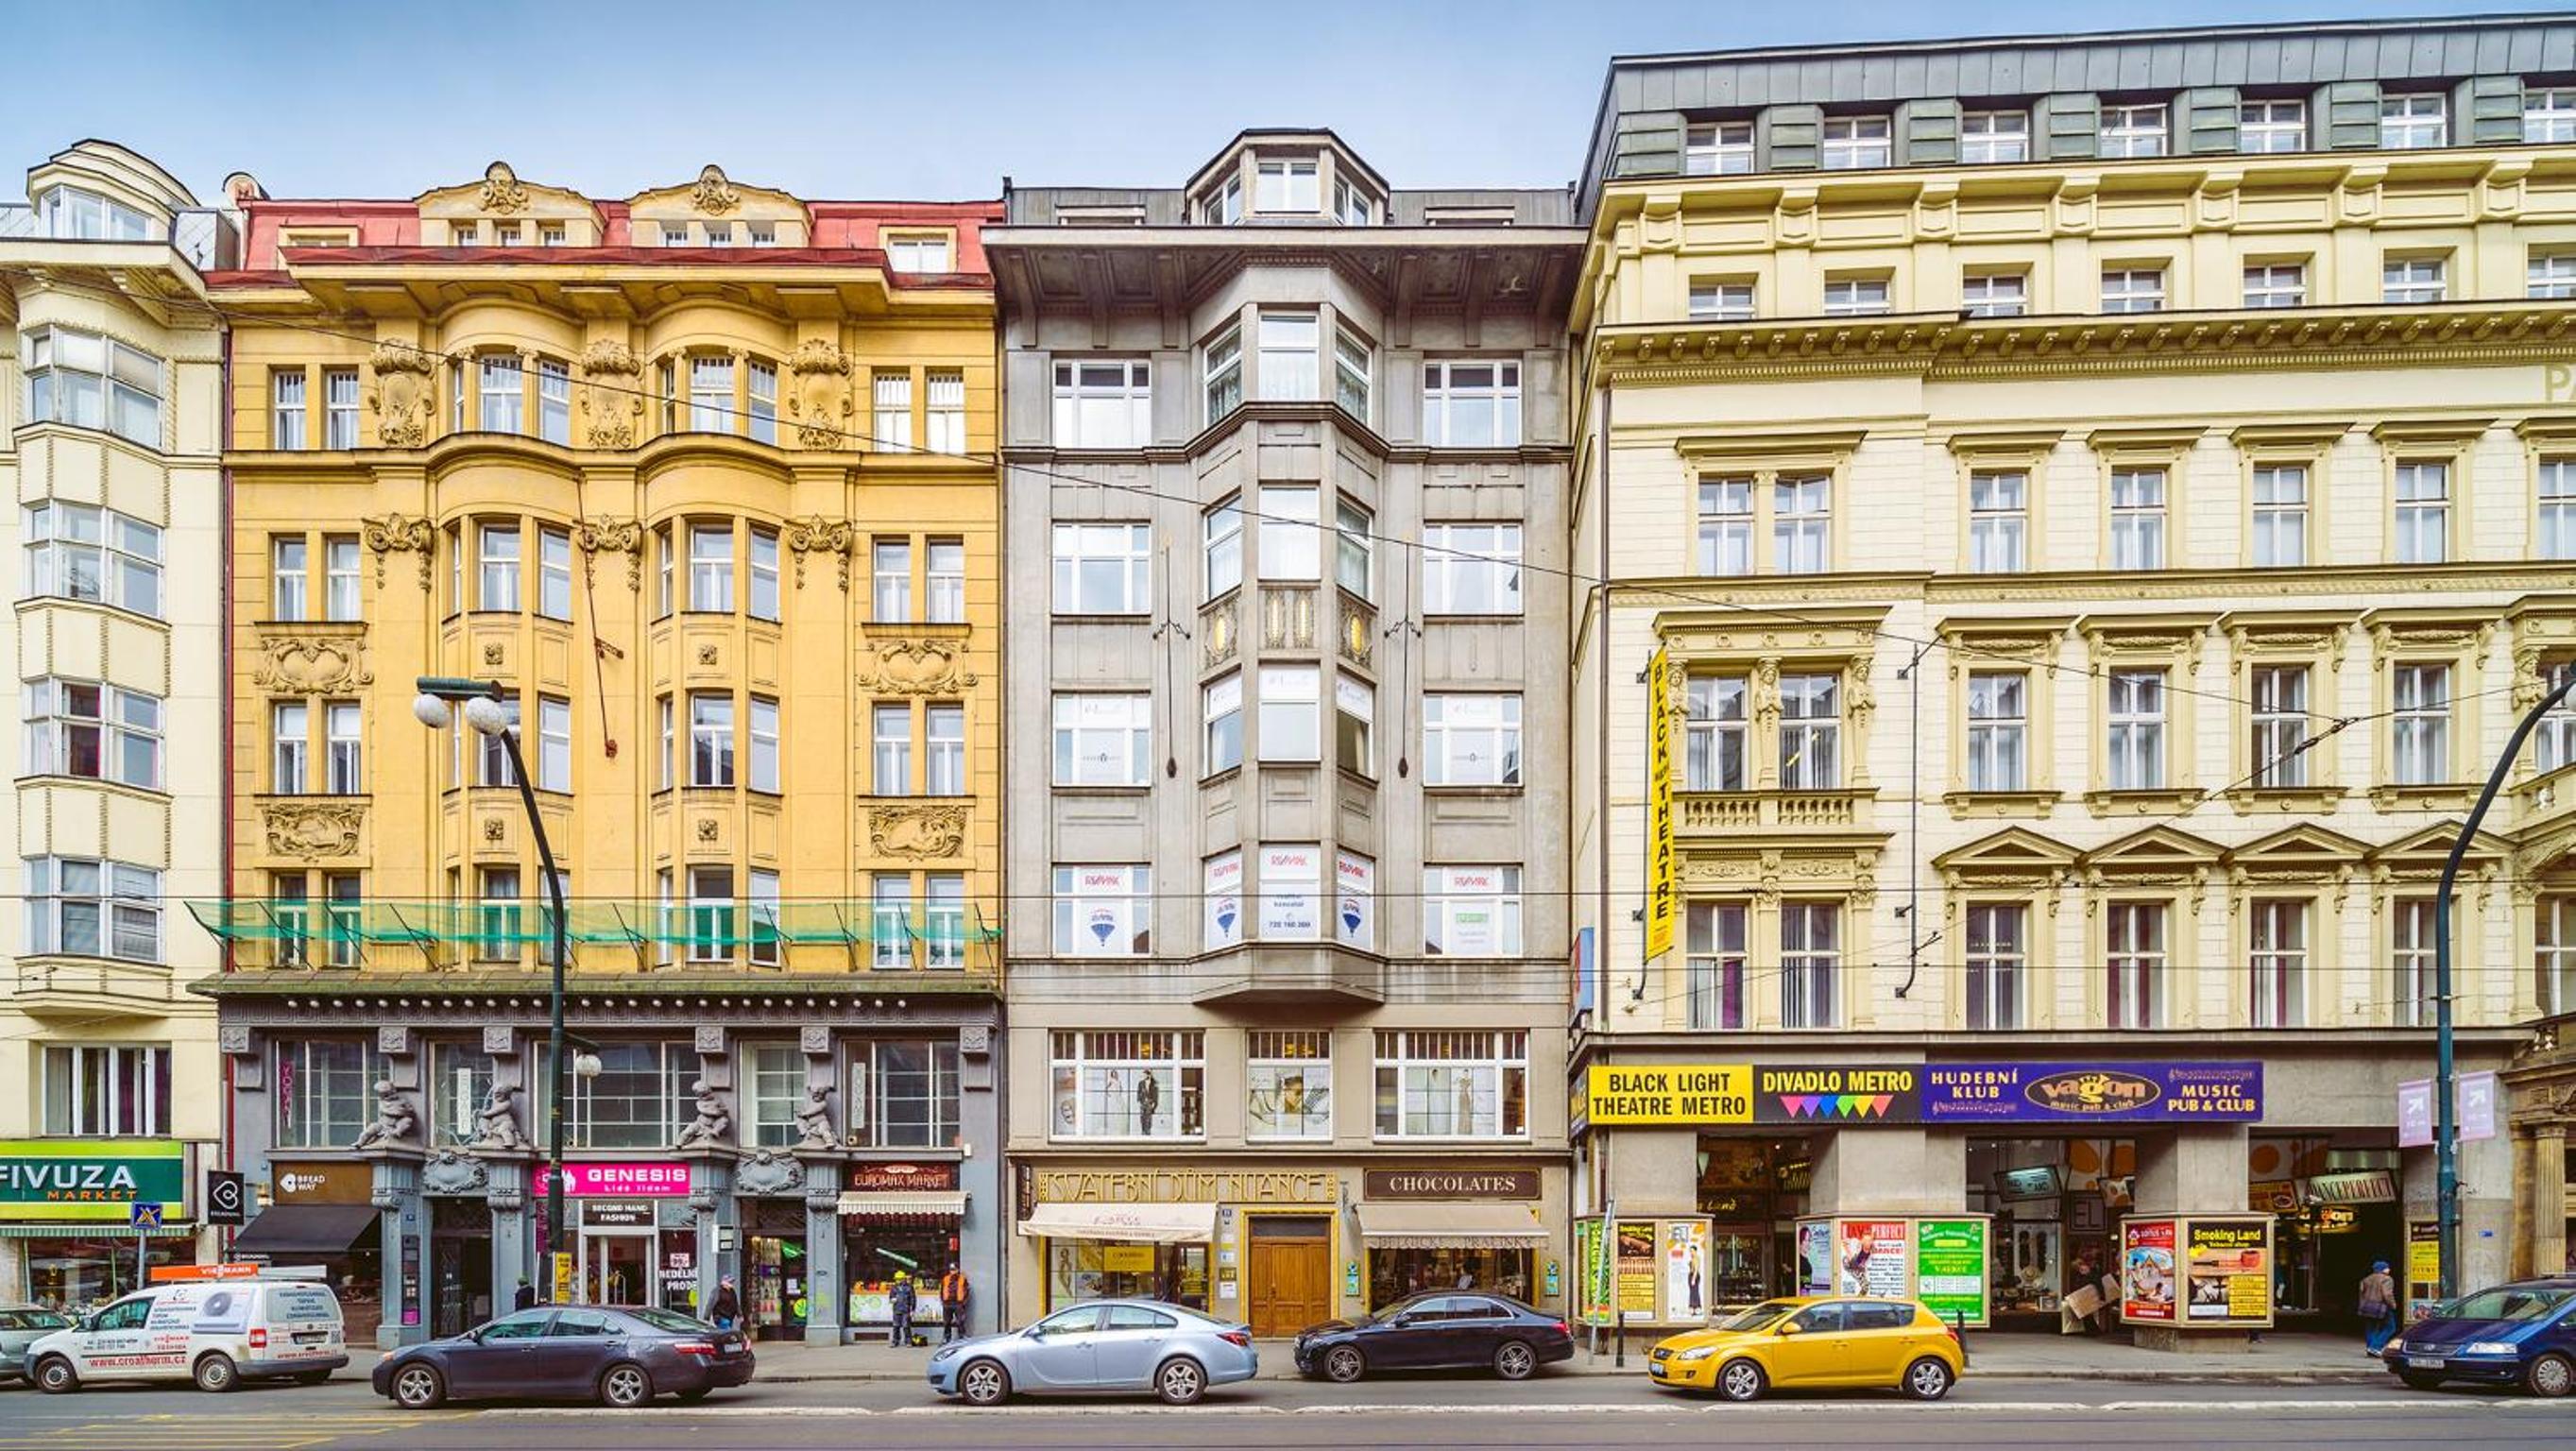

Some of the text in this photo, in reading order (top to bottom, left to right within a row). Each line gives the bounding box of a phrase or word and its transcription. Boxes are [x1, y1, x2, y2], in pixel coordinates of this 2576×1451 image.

[2546, 363, 2576, 401] P
[1654, 663, 1667, 763] BLACK
[1656, 781, 1670, 920] THEATRE
[1609, 1072, 1731, 1093] BLACK LIGHT
[1763, 1070, 1913, 1092] DIVADLO METRO
[1931, 1067, 2019, 1084] HUDEBNÍ
[1952, 1085, 2001, 1099] KLUB
[2041, 1073, 2145, 1104] vagon
[2181, 1084, 2243, 1098] MUSIC
[1594, 1096, 1746, 1116] THEATRE METRO
[2082, 1102, 2102, 1112] pub
[2167, 1099, 2256, 1112] PUB & CLUB
[297, 1174, 326, 1184] BREAD
[587, 1168, 688, 1183] GENESIS
[854, 1173, 949, 1188] EUROMAX MARKET
[1229, 1172, 1326, 1203] NUANCE
[1389, 1176, 1517, 1192] CHOCOLATES
[46, 1190, 138, 1201] MARKET
[600, 1214, 637, 1222] FASHION
[2193, 1229, 2261, 1241] Smoking Land
